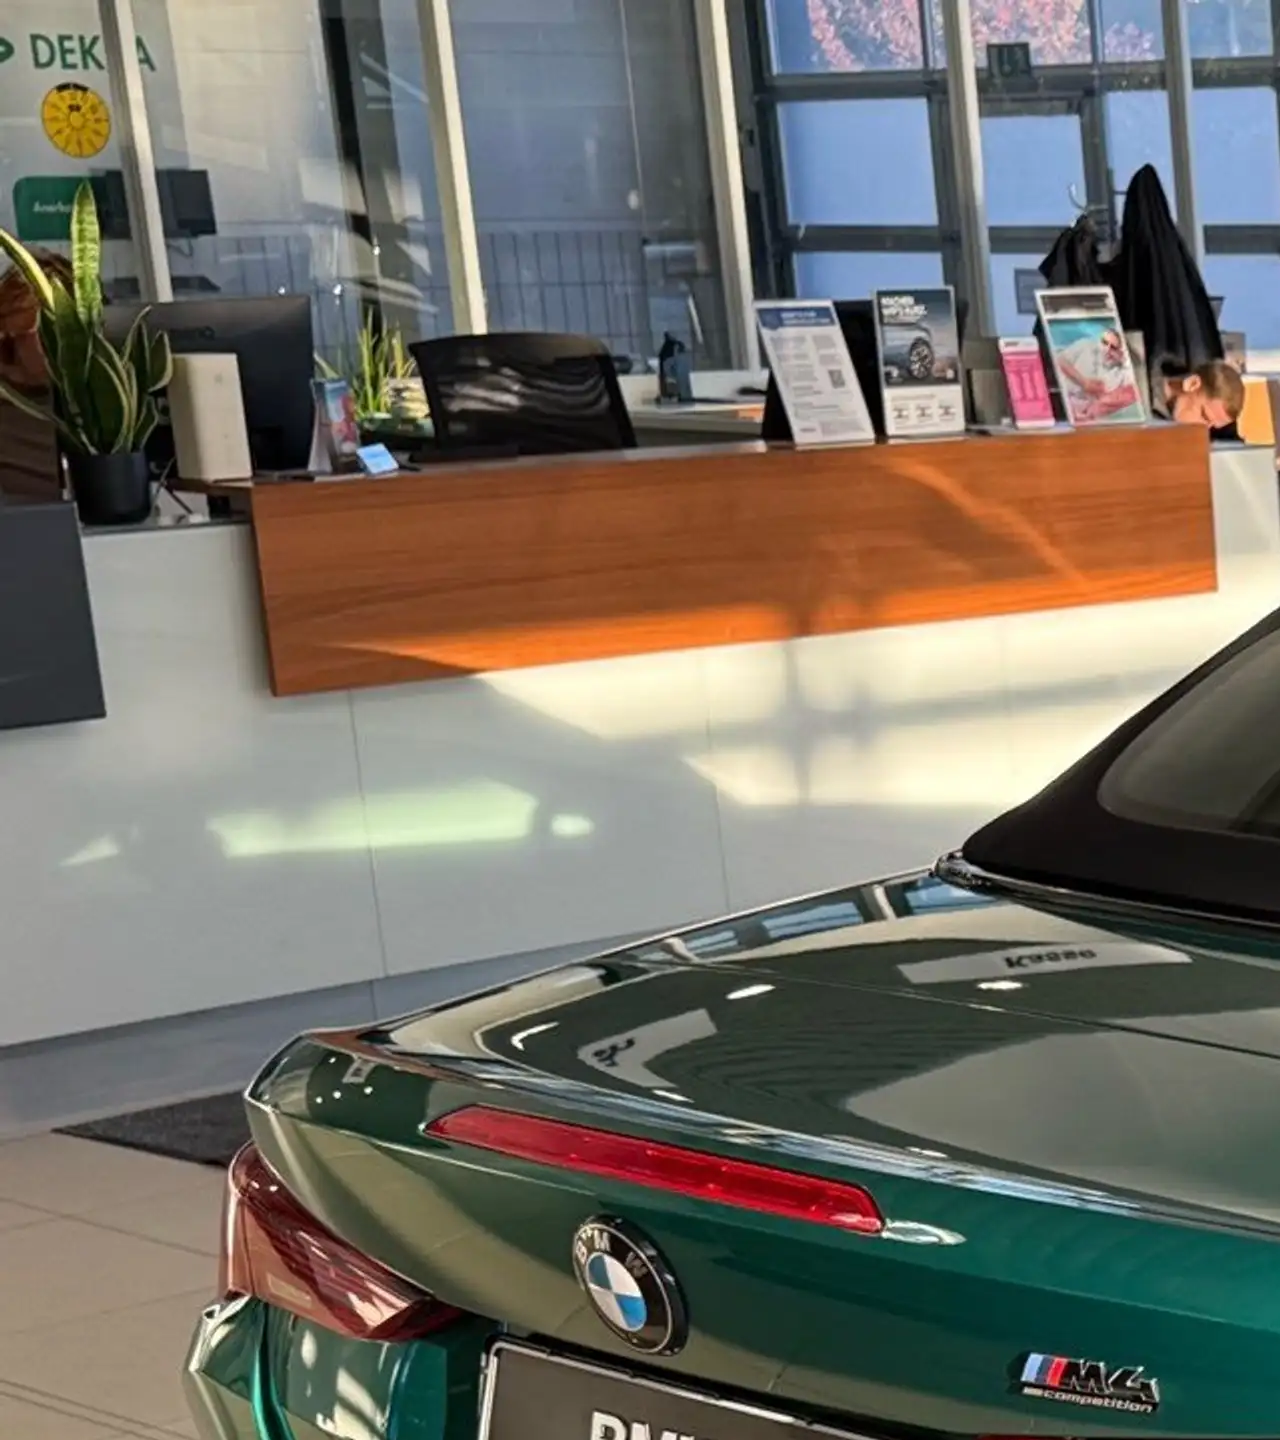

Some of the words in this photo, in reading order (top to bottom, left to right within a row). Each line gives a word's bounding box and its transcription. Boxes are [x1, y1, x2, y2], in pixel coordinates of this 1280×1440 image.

[29, 33, 157, 71] DEKA
[575, 1227, 649, 1278] BMW
[1059, 1358, 1160, 1403] M4
[1043, 1390, 1153, 1413] competition
